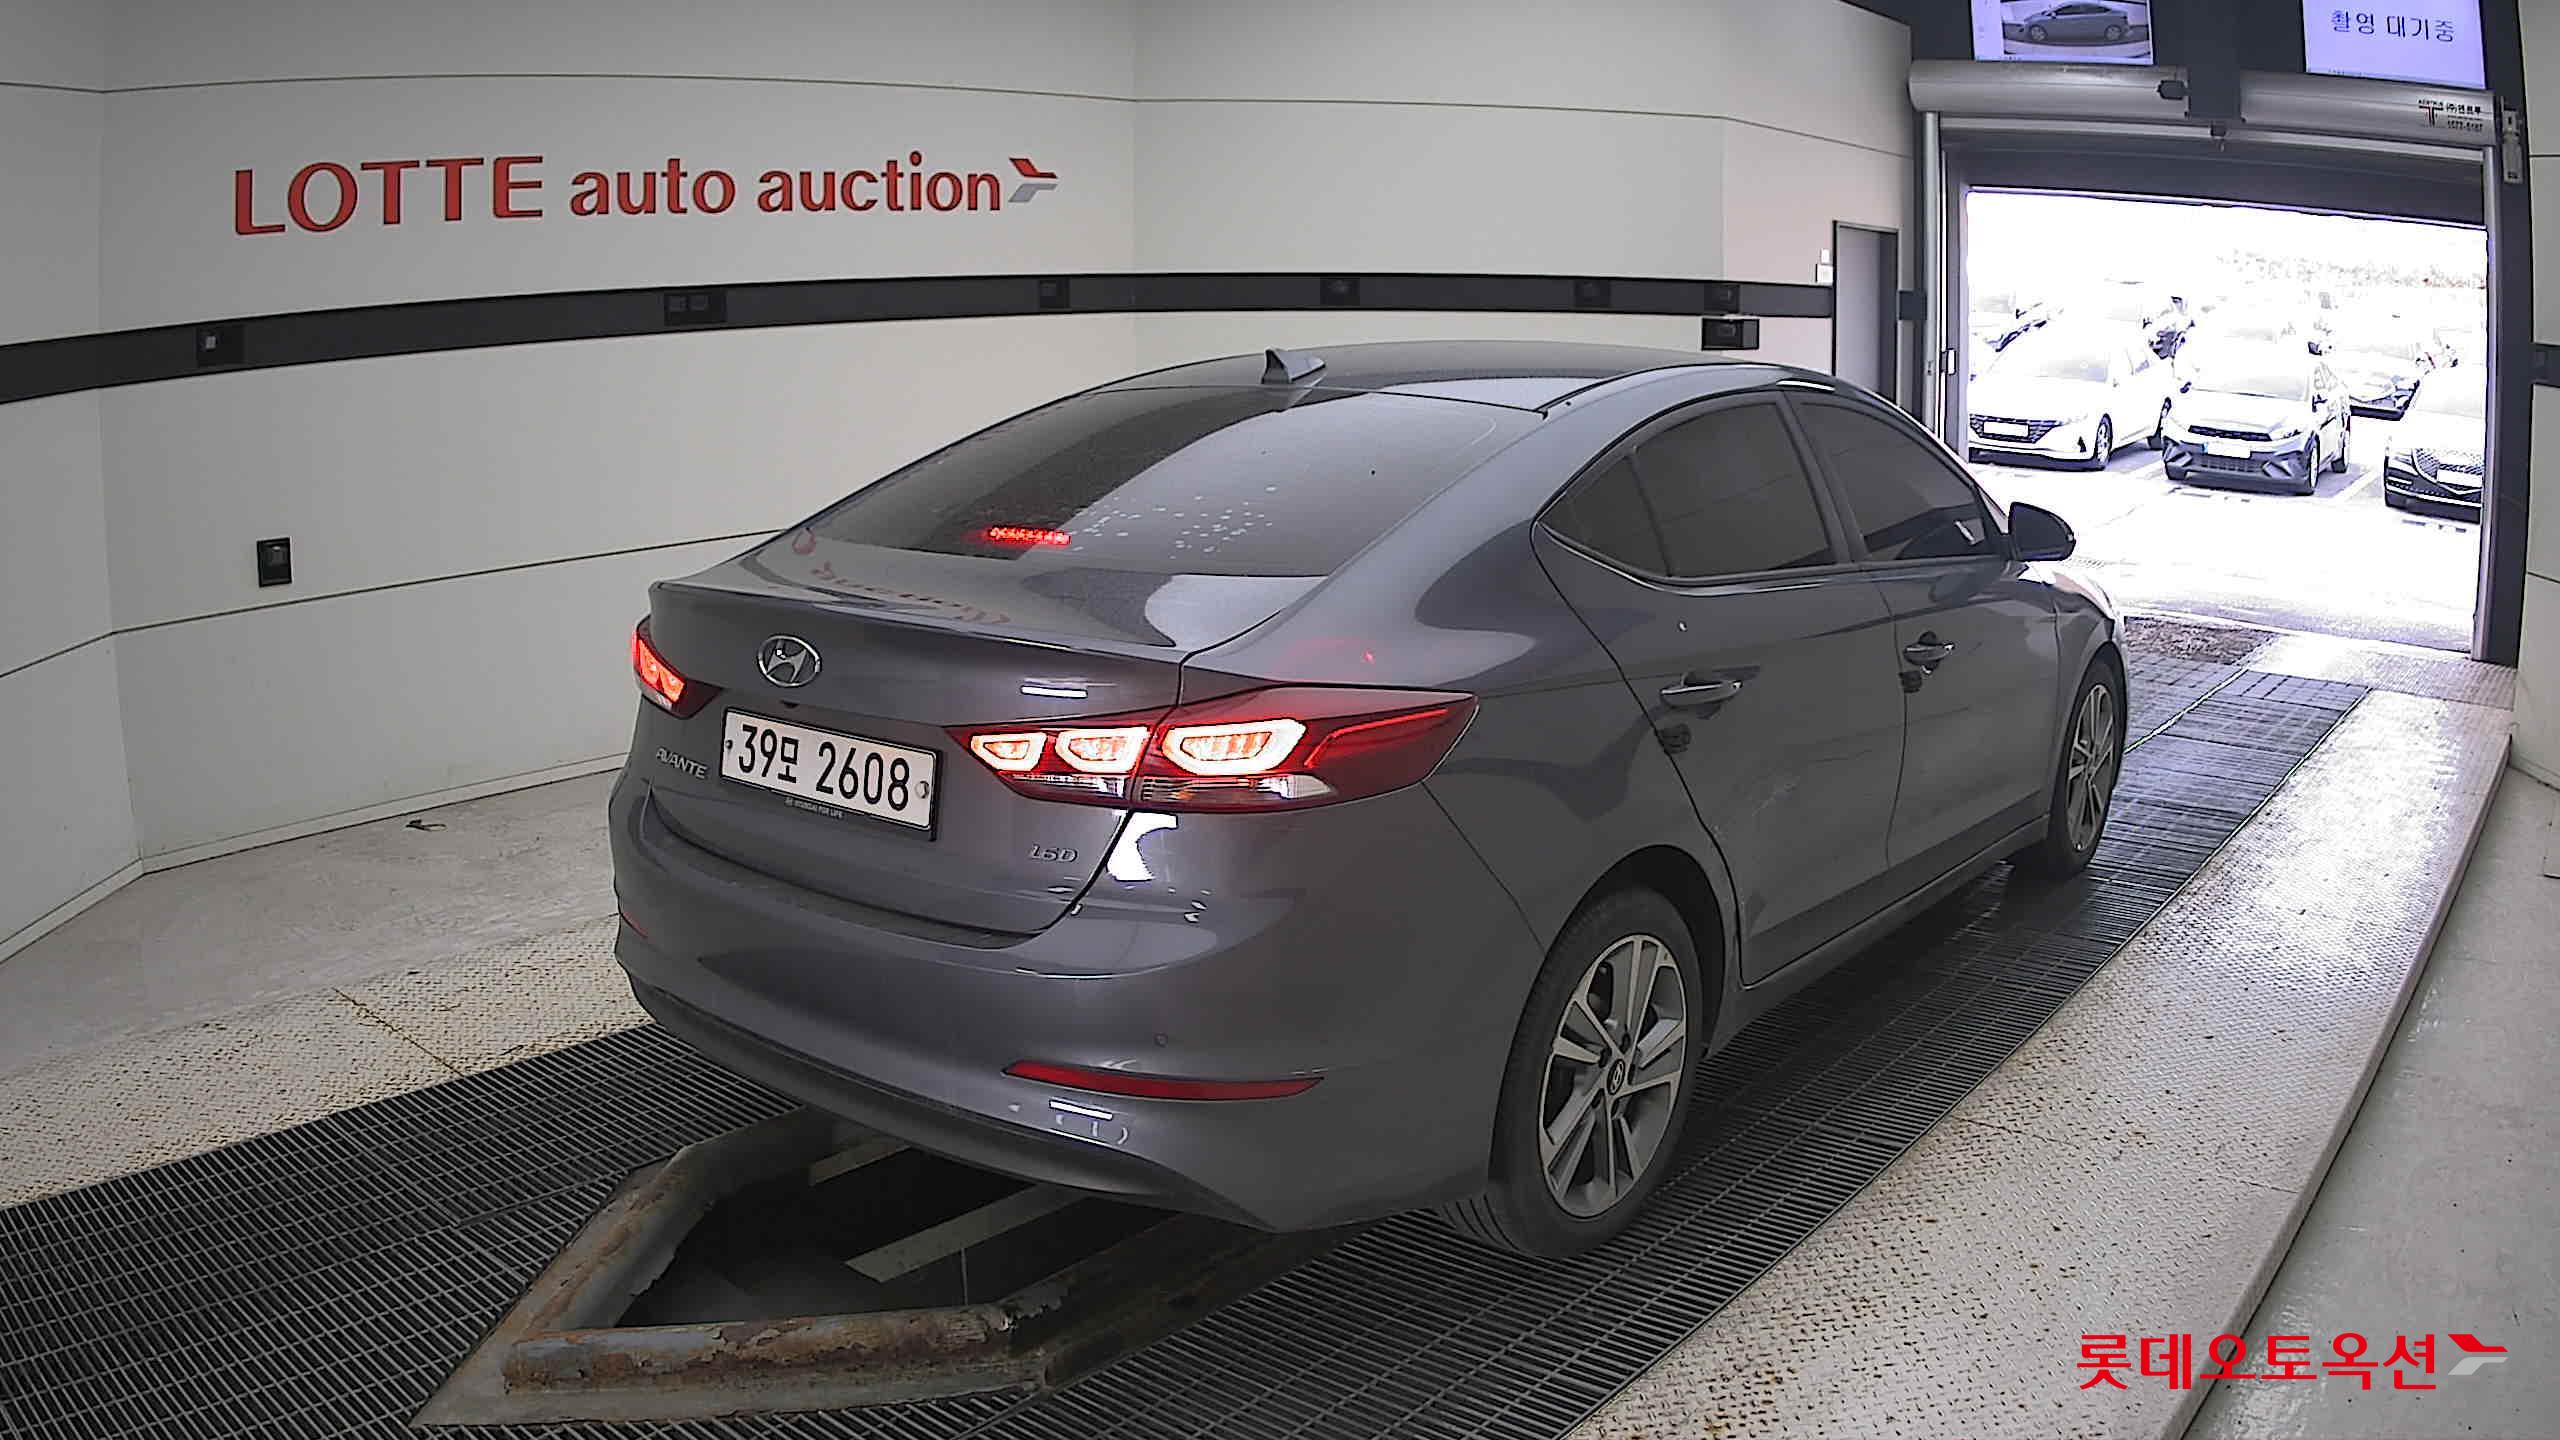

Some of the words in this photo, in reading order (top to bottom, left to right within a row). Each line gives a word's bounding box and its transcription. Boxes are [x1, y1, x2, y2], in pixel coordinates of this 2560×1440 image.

[2331, 10, 2375, 34] 촬영
[235, 155, 544, 235] LOTTE
[569, 157, 736, 215] auto
[756, 150, 1001, 213] auction
[655, 746, 708, 779] AVANTE
[738, 724, 799, 784] 39모
[815, 741, 910, 812] 2608
